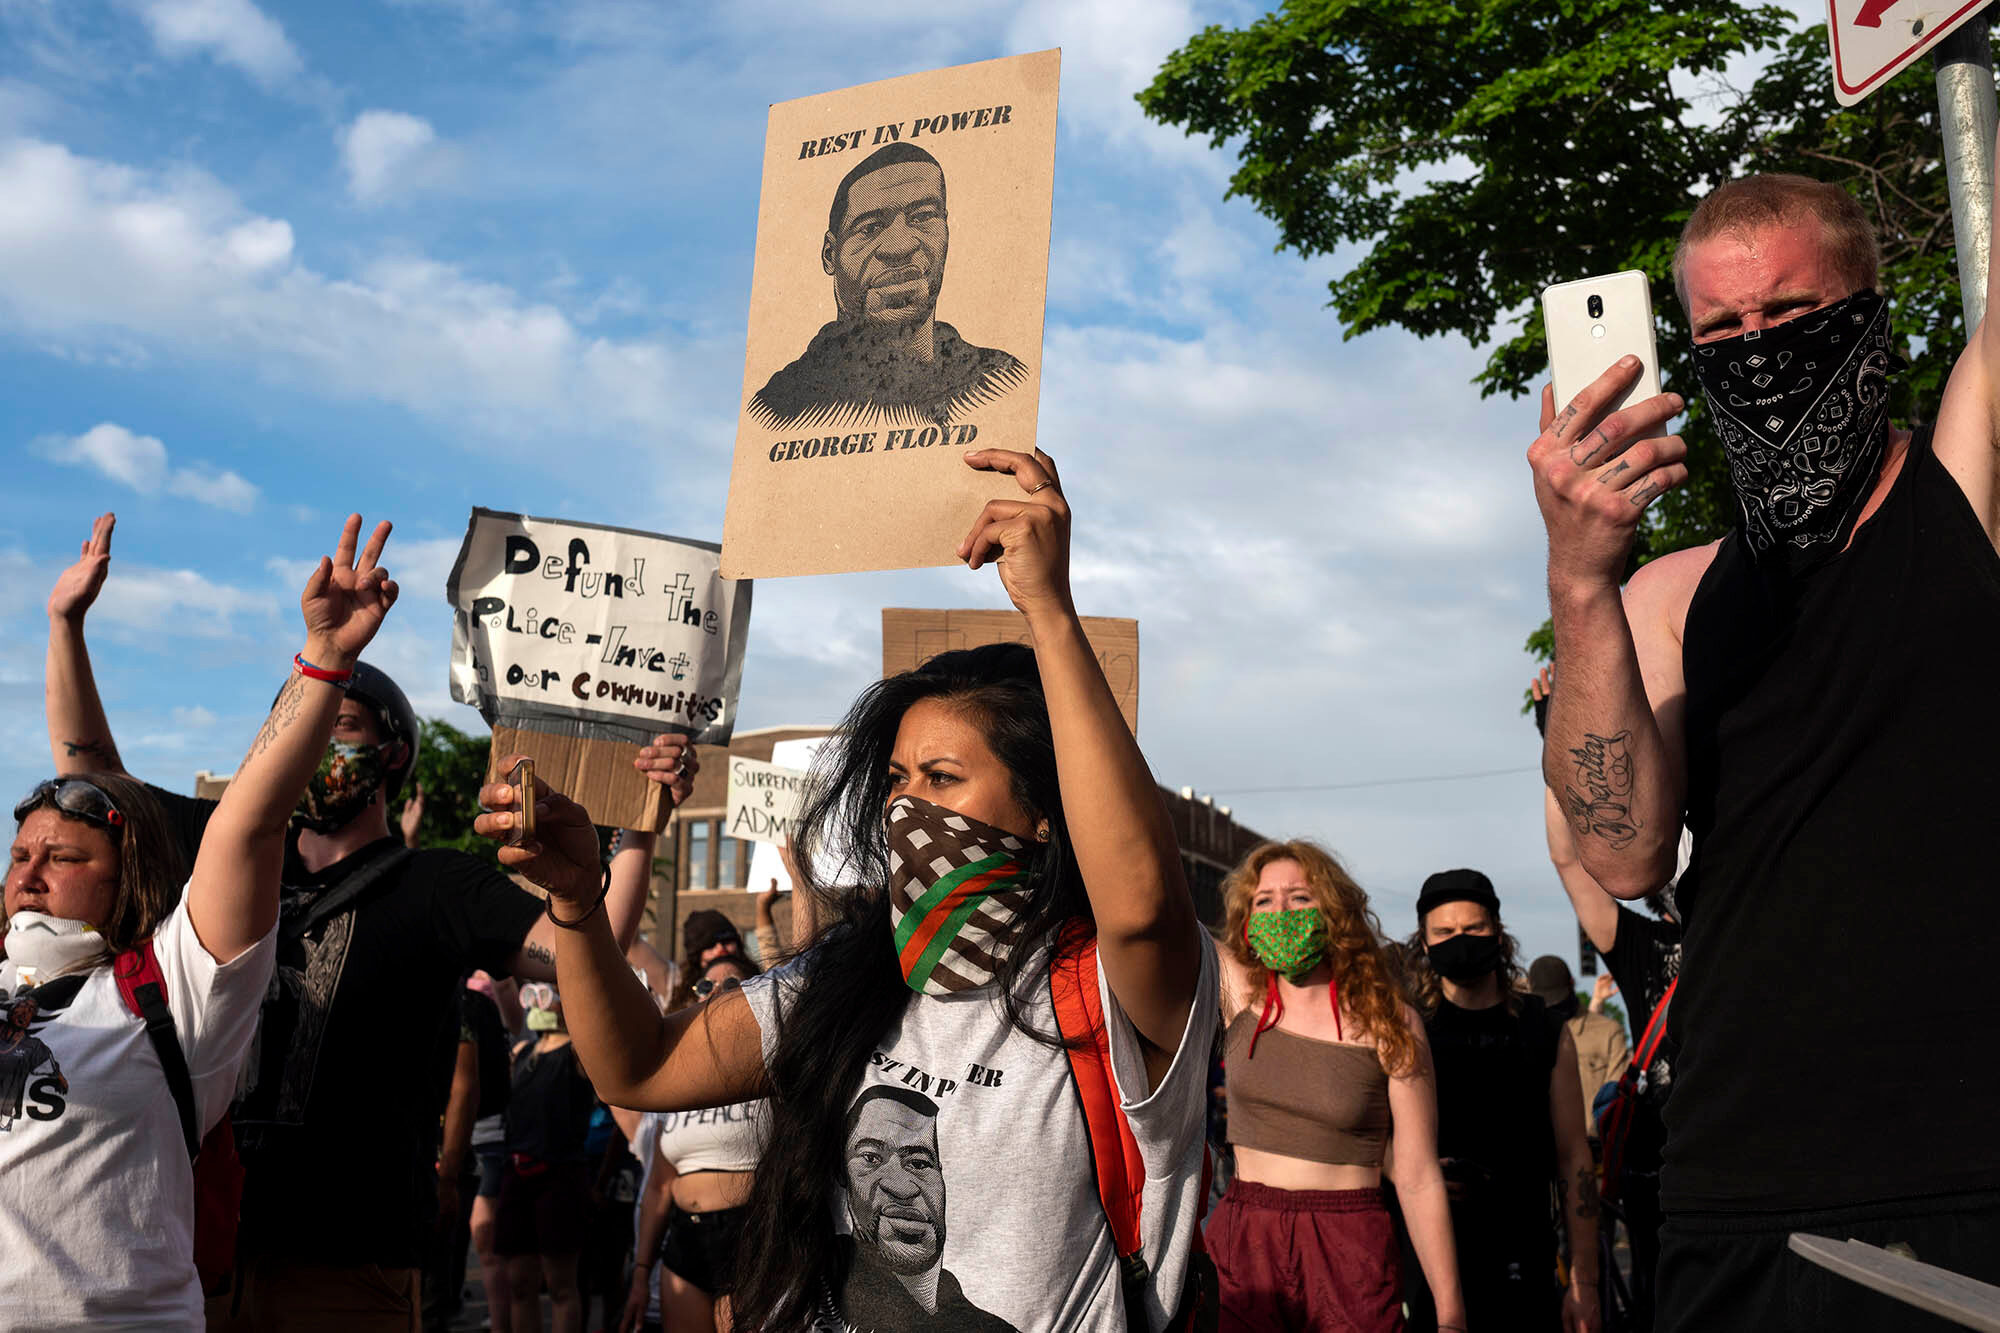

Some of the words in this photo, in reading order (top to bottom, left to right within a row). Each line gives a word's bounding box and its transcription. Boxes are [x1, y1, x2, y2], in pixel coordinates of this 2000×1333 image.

[798, 129, 866, 160] REST
[872, 122, 905, 146] IN
[910, 105, 1013, 138] POWER
[769, 431, 878, 463] GEORGE
[884, 424, 978, 452] FLOYD
[505, 535, 646, 598] Defund
[764, 790, 774, 808] &
[900, 1066, 935, 1092] IN
